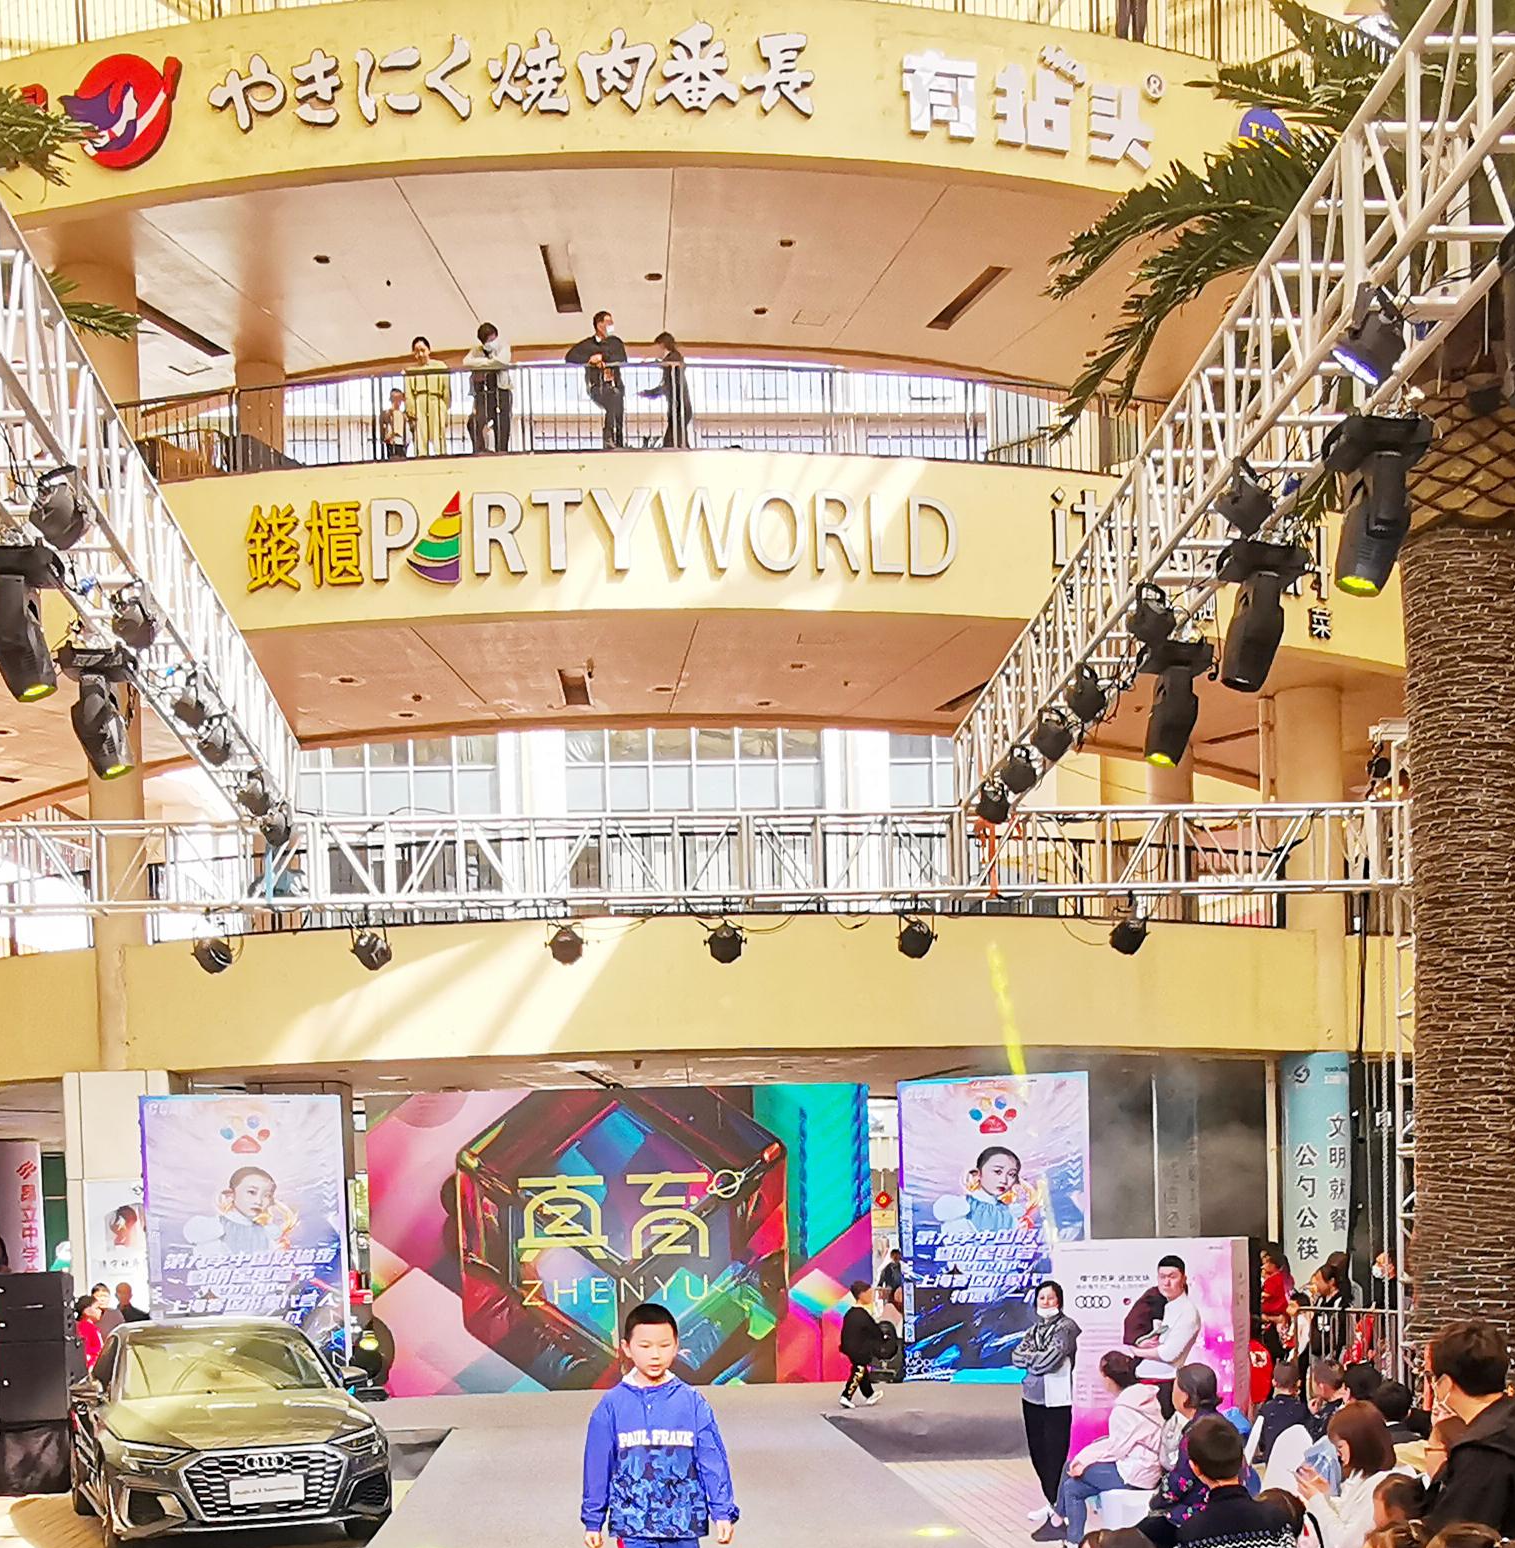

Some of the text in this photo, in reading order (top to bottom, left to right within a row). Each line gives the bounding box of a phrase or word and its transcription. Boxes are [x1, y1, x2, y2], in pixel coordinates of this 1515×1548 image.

[208, 20, 816, 134] やきにく焼肉番長
[1295, 1143, 1320, 1261] 公勺公筷
[1327, 1112, 1348, 1233] 文明就餐
[522, 1273, 709, 1306] ZHENYU
[617, 1429, 695, 1448] PAUL FRANK
